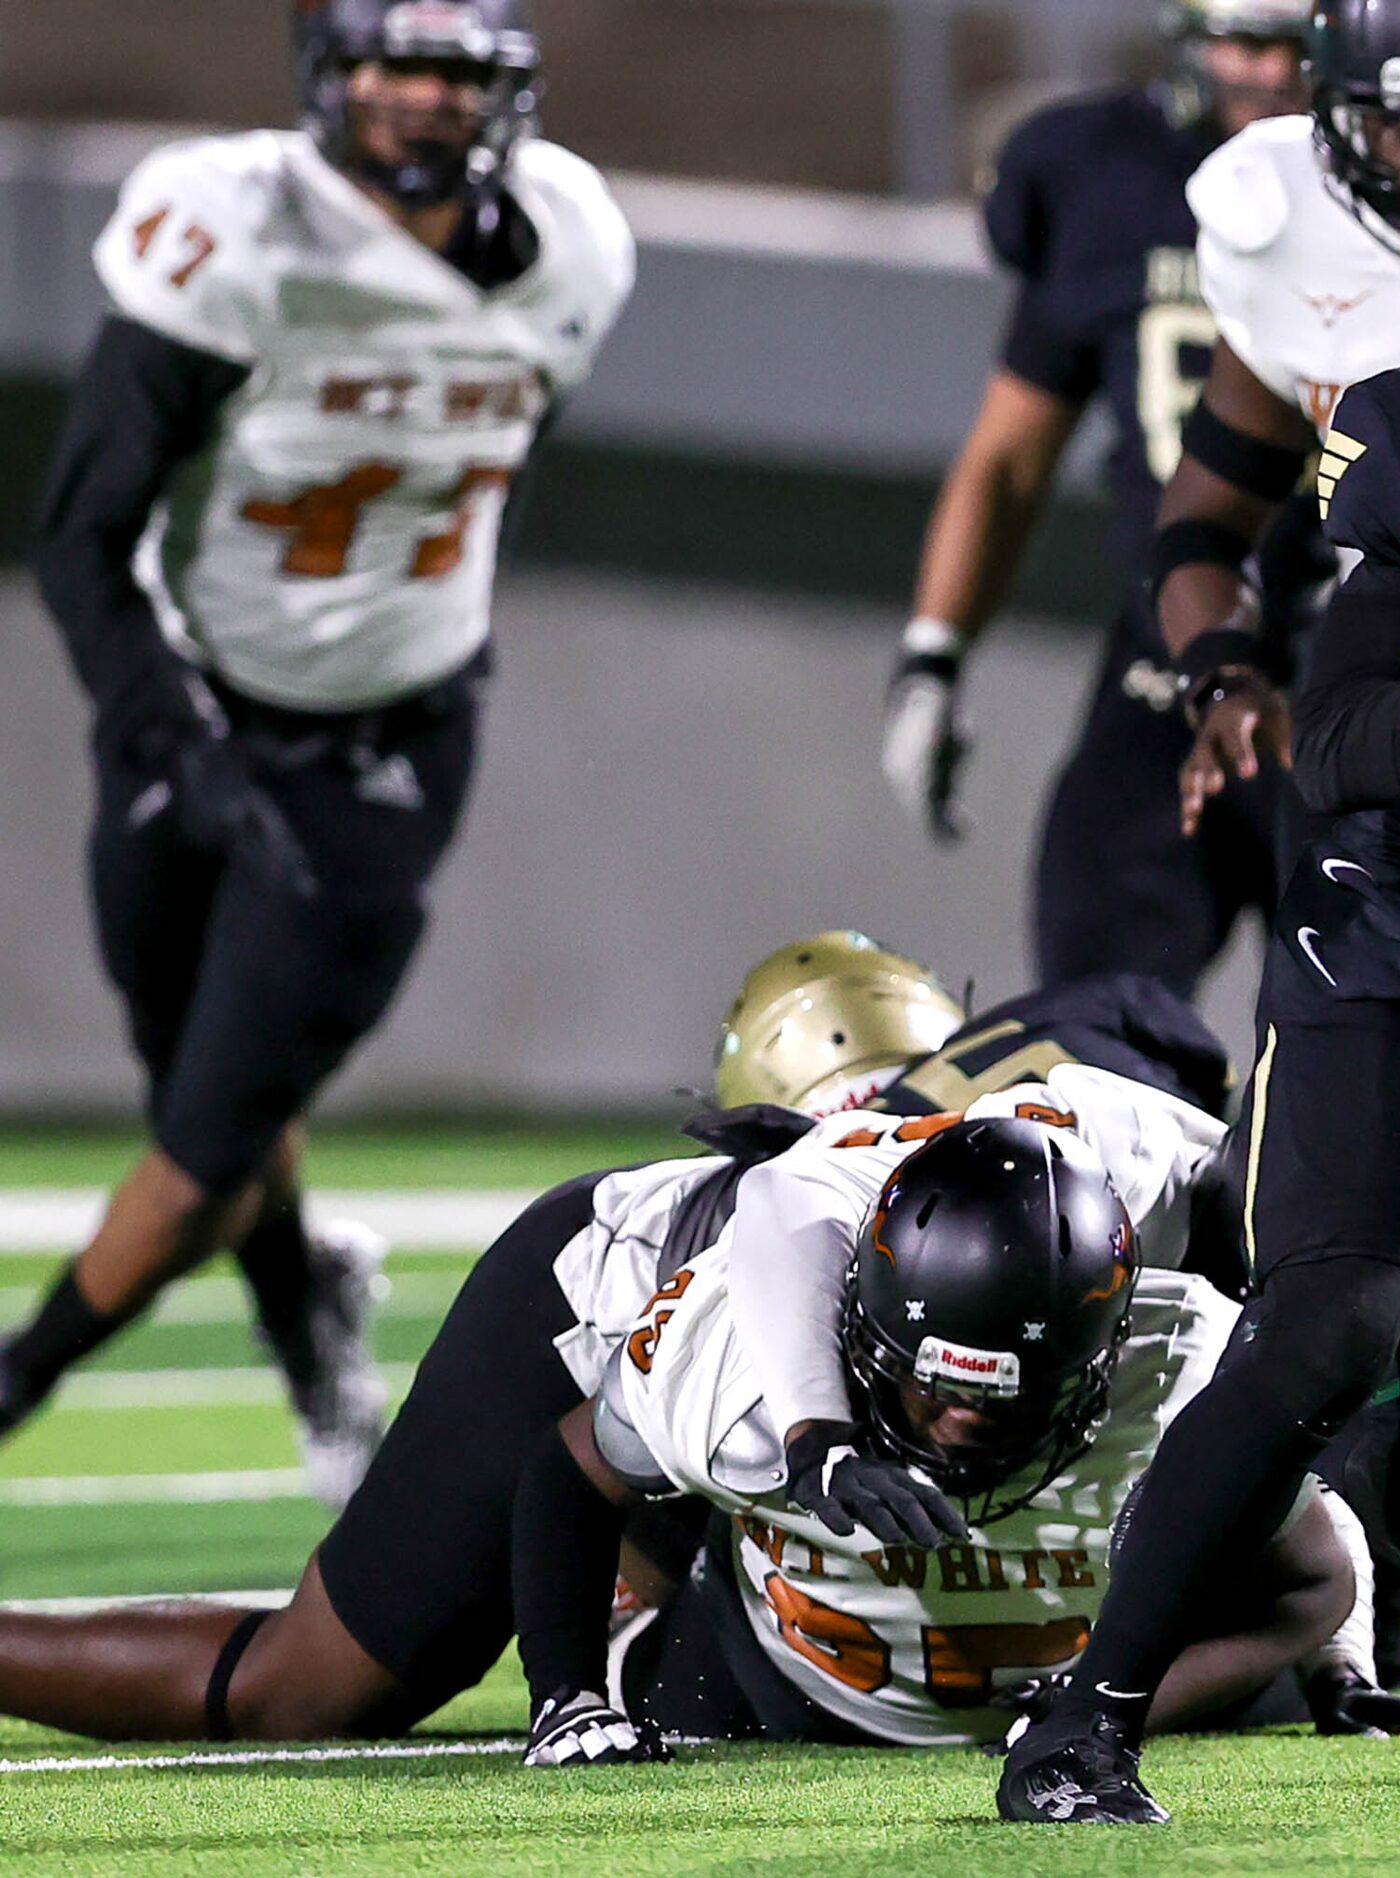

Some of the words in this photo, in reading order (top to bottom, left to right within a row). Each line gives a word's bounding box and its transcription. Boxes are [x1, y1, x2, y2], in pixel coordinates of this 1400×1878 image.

[238, 460, 509, 580] 47
[941, 1347, 998, 1374] Riddell
[860, 1545, 1095, 1592] WHITE
